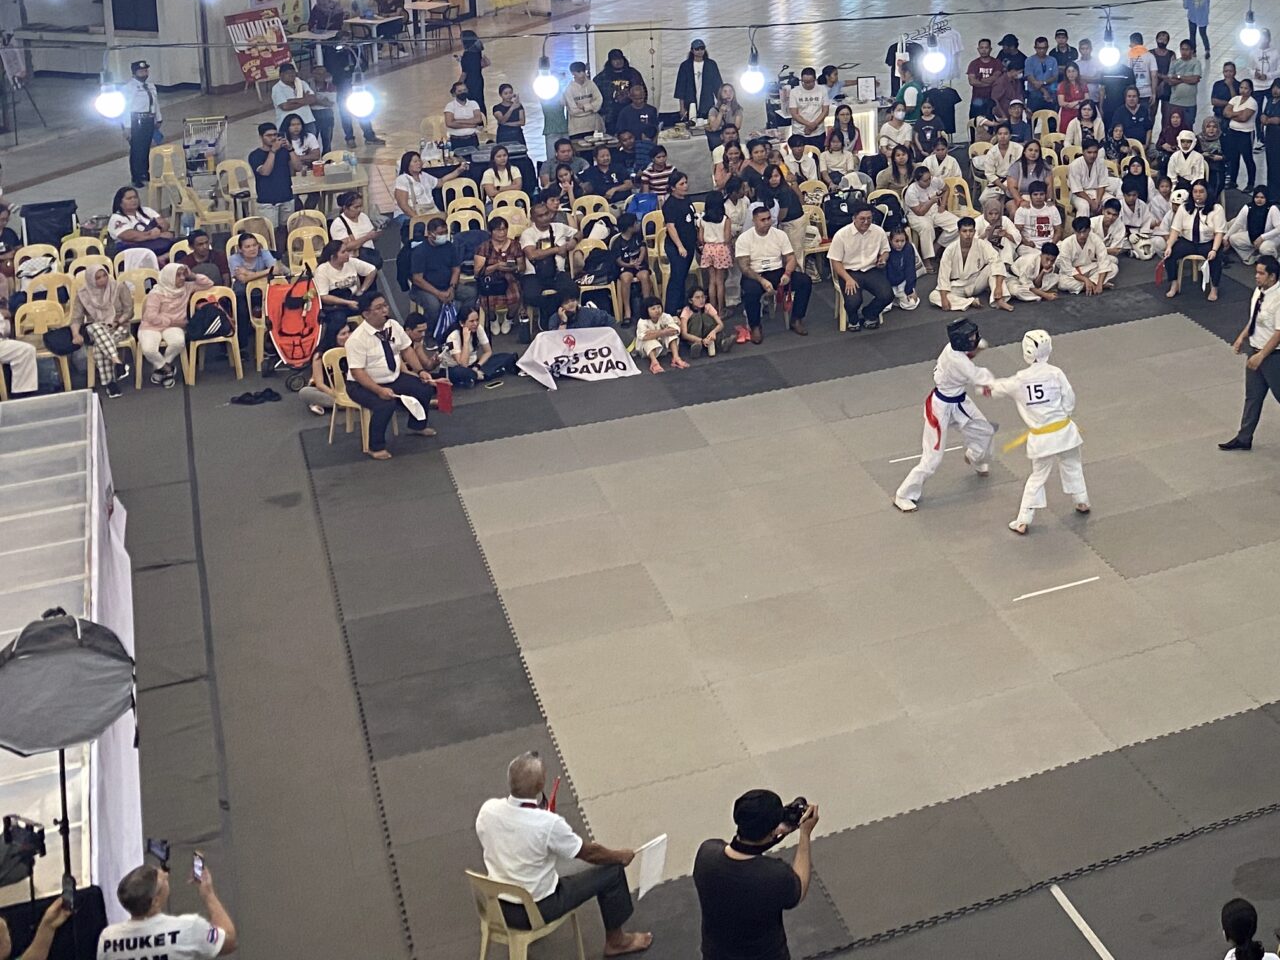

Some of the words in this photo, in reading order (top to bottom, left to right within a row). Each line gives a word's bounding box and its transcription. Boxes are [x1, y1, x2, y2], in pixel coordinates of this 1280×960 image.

[583, 346, 612, 361] GO
[1026, 384, 1044, 401] 15
[103, 930, 180, 953] PHUKET
